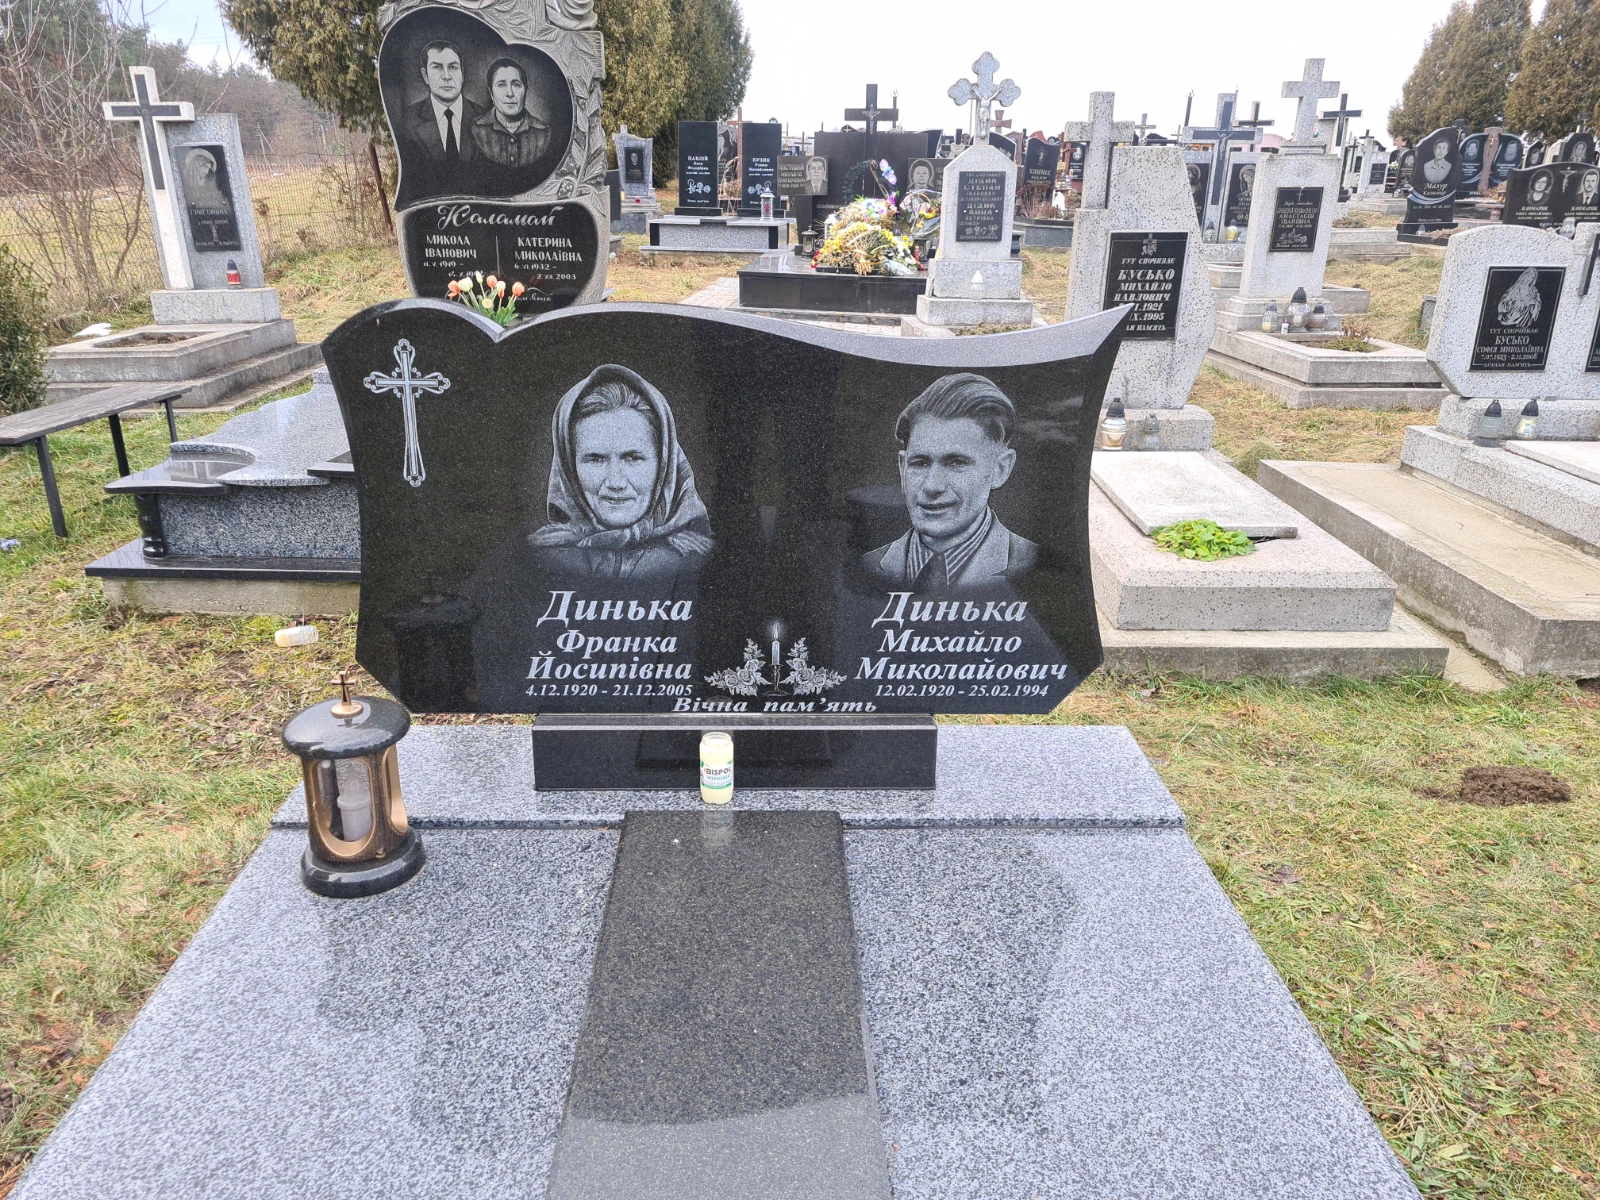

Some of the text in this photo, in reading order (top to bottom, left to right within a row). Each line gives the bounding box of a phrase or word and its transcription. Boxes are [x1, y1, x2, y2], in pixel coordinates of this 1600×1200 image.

[426, 234, 471, 246] МИКОЛА
[517, 237, 573, 248] КАТЕРИНА
[425, 248, 477, 259] ІВАНОВИЧ
[515, 250, 582, 262] МИКОЛАЇВНА
[1121, 257, 1176, 265] ТУТ СПОЧИВАЄ
[1117, 268, 1175, 281] БУСЬКО
[1117, 281, 1173, 291] МИХАЙЛО
[1112, 293, 1171, 302] ПАВЛОВИЧ
[1495, 335, 1530, 345] БУСЬКО
[1500, 344, 1544, 353] МИКОЛАЇВНА
[536, 590, 693, 628] Динька
[871, 591, 1028, 628] Динька
[556, 629, 678, 660] Франка
[877, 629, 1022, 653] Михайло
[525, 650, 692, 680] Йосипівна
[854, 656, 1068, 680] Миколайович
[525, 684, 598, 696] 4.12.1920
[612, 684, 693, 696] 21.12.2005
[875, 684, 955, 697] 12.02.1920
[968, 684, 1049, 697] 25.02.1994
[671, 698, 748, 712] Вічна
